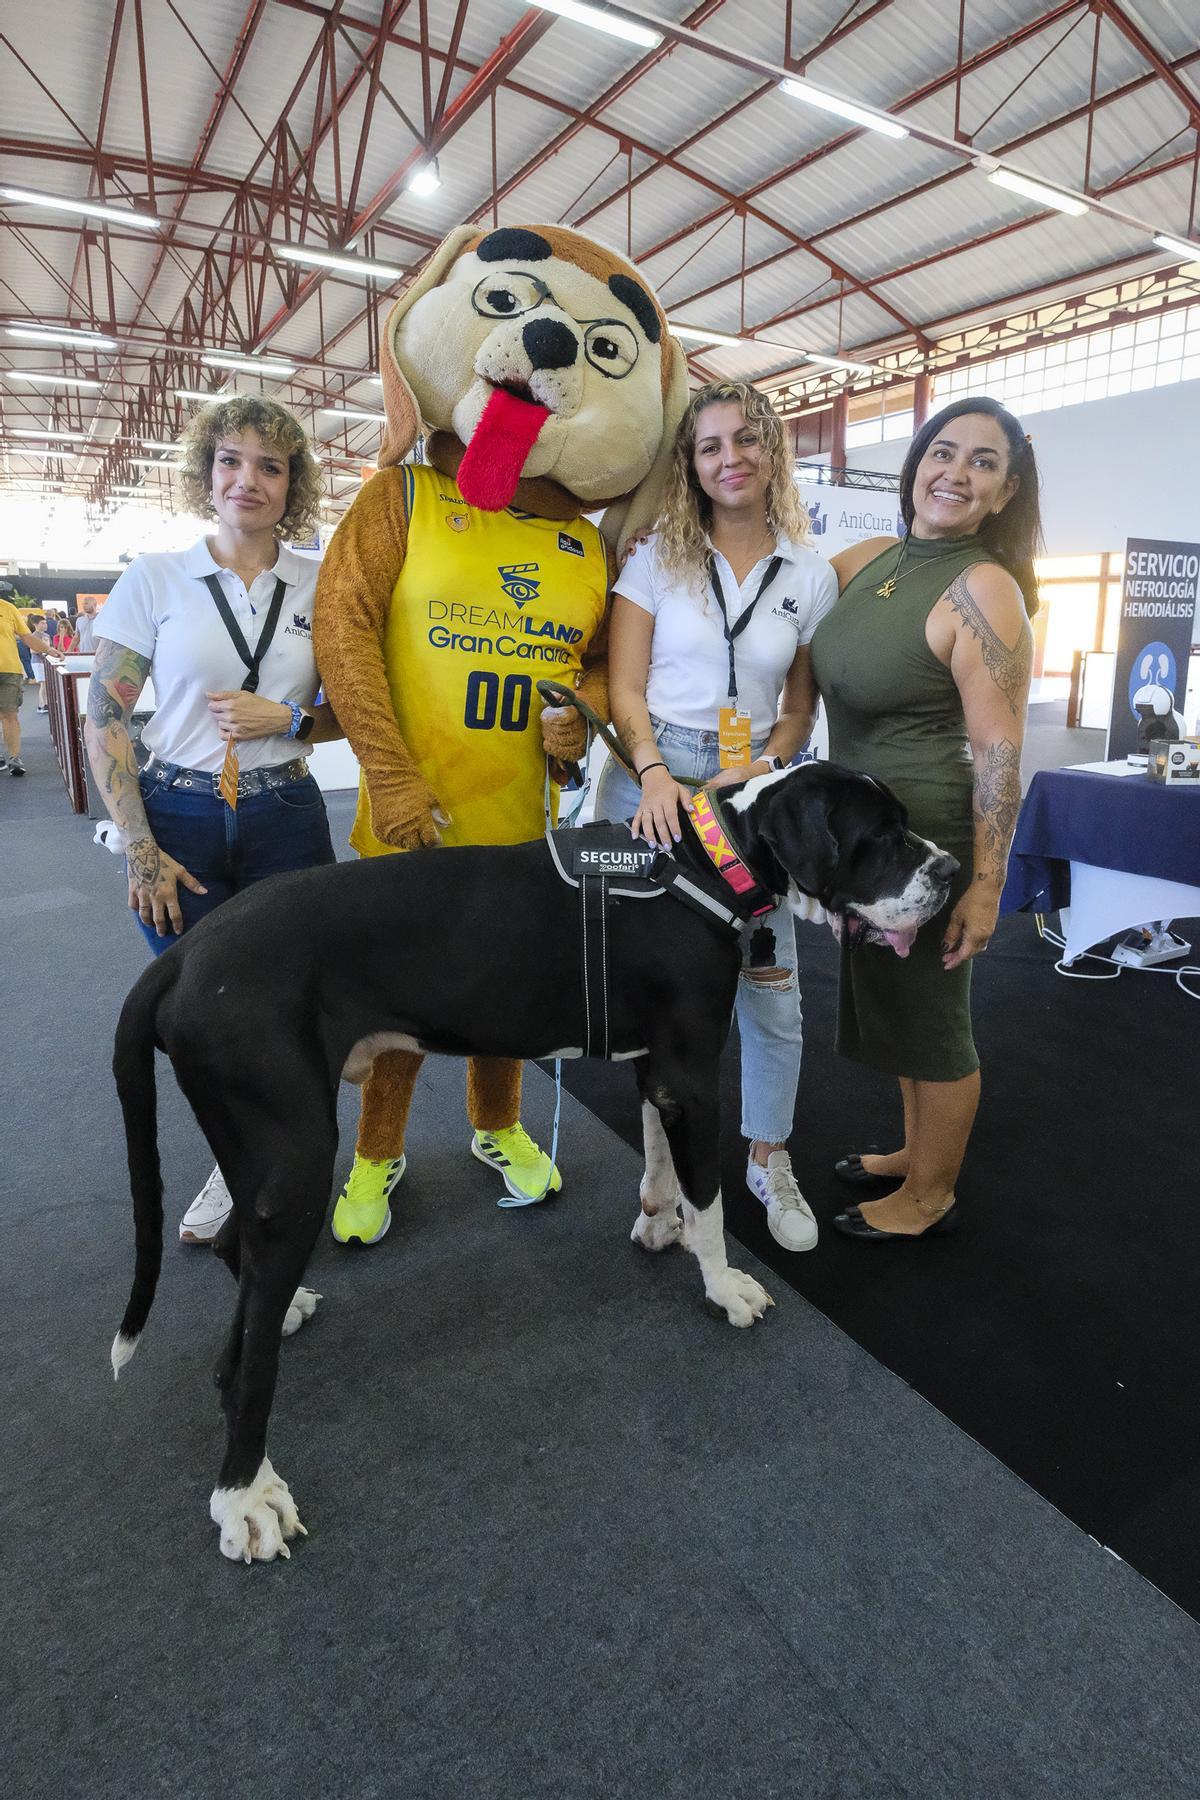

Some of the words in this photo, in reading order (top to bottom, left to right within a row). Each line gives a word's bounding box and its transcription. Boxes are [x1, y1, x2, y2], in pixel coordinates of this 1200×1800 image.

[838, 510, 892, 531] AniCura
[1127, 551, 1199, 578] SERVICIO
[1125, 579, 1195, 598] NEFROLOGÍA
[1123, 600, 1194, 618] HEMODIÁLISIS
[428, 600, 583, 645] DREAMLAND
[428, 625, 493, 654] Gran
[464, 670, 532, 732] 00
[580, 851, 656, 865] SECURITY
